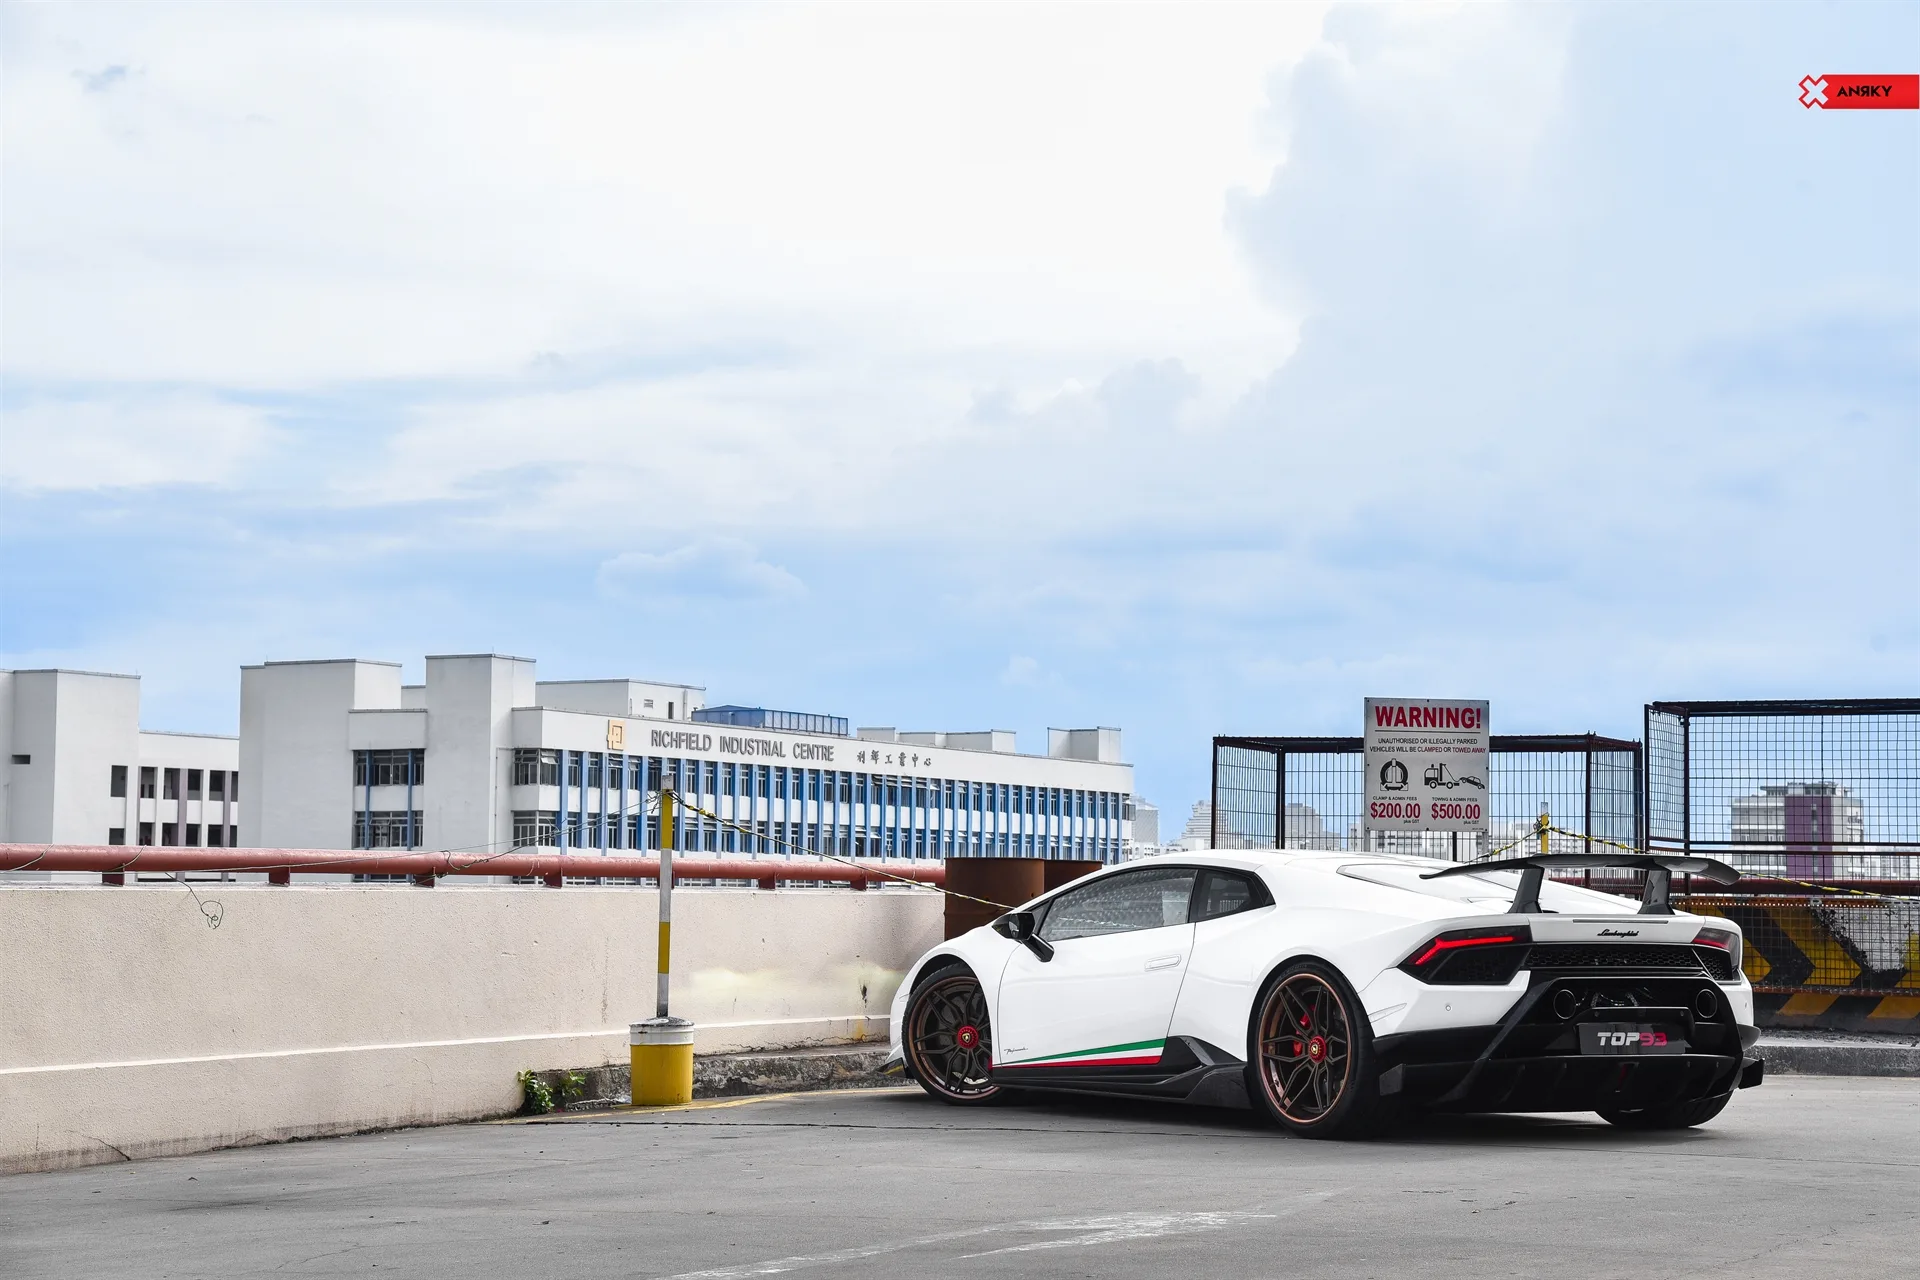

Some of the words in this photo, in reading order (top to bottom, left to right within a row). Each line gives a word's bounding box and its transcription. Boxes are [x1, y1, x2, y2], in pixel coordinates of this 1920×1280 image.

[1375, 706, 1481, 729] WARNING!
[651, 729, 712, 751] RICHFIELD
[719, 735, 786, 758] INDUSTRIAL
[792, 742, 834, 761] CENTRE
[1420, 737, 1428, 745] OR
[1452, 746, 1472, 754] TOWED
[1370, 801, 1421, 820] $200.00
[1431, 802, 1481, 821] $500.00
[1597, 1032, 1668, 1047] TOP93
